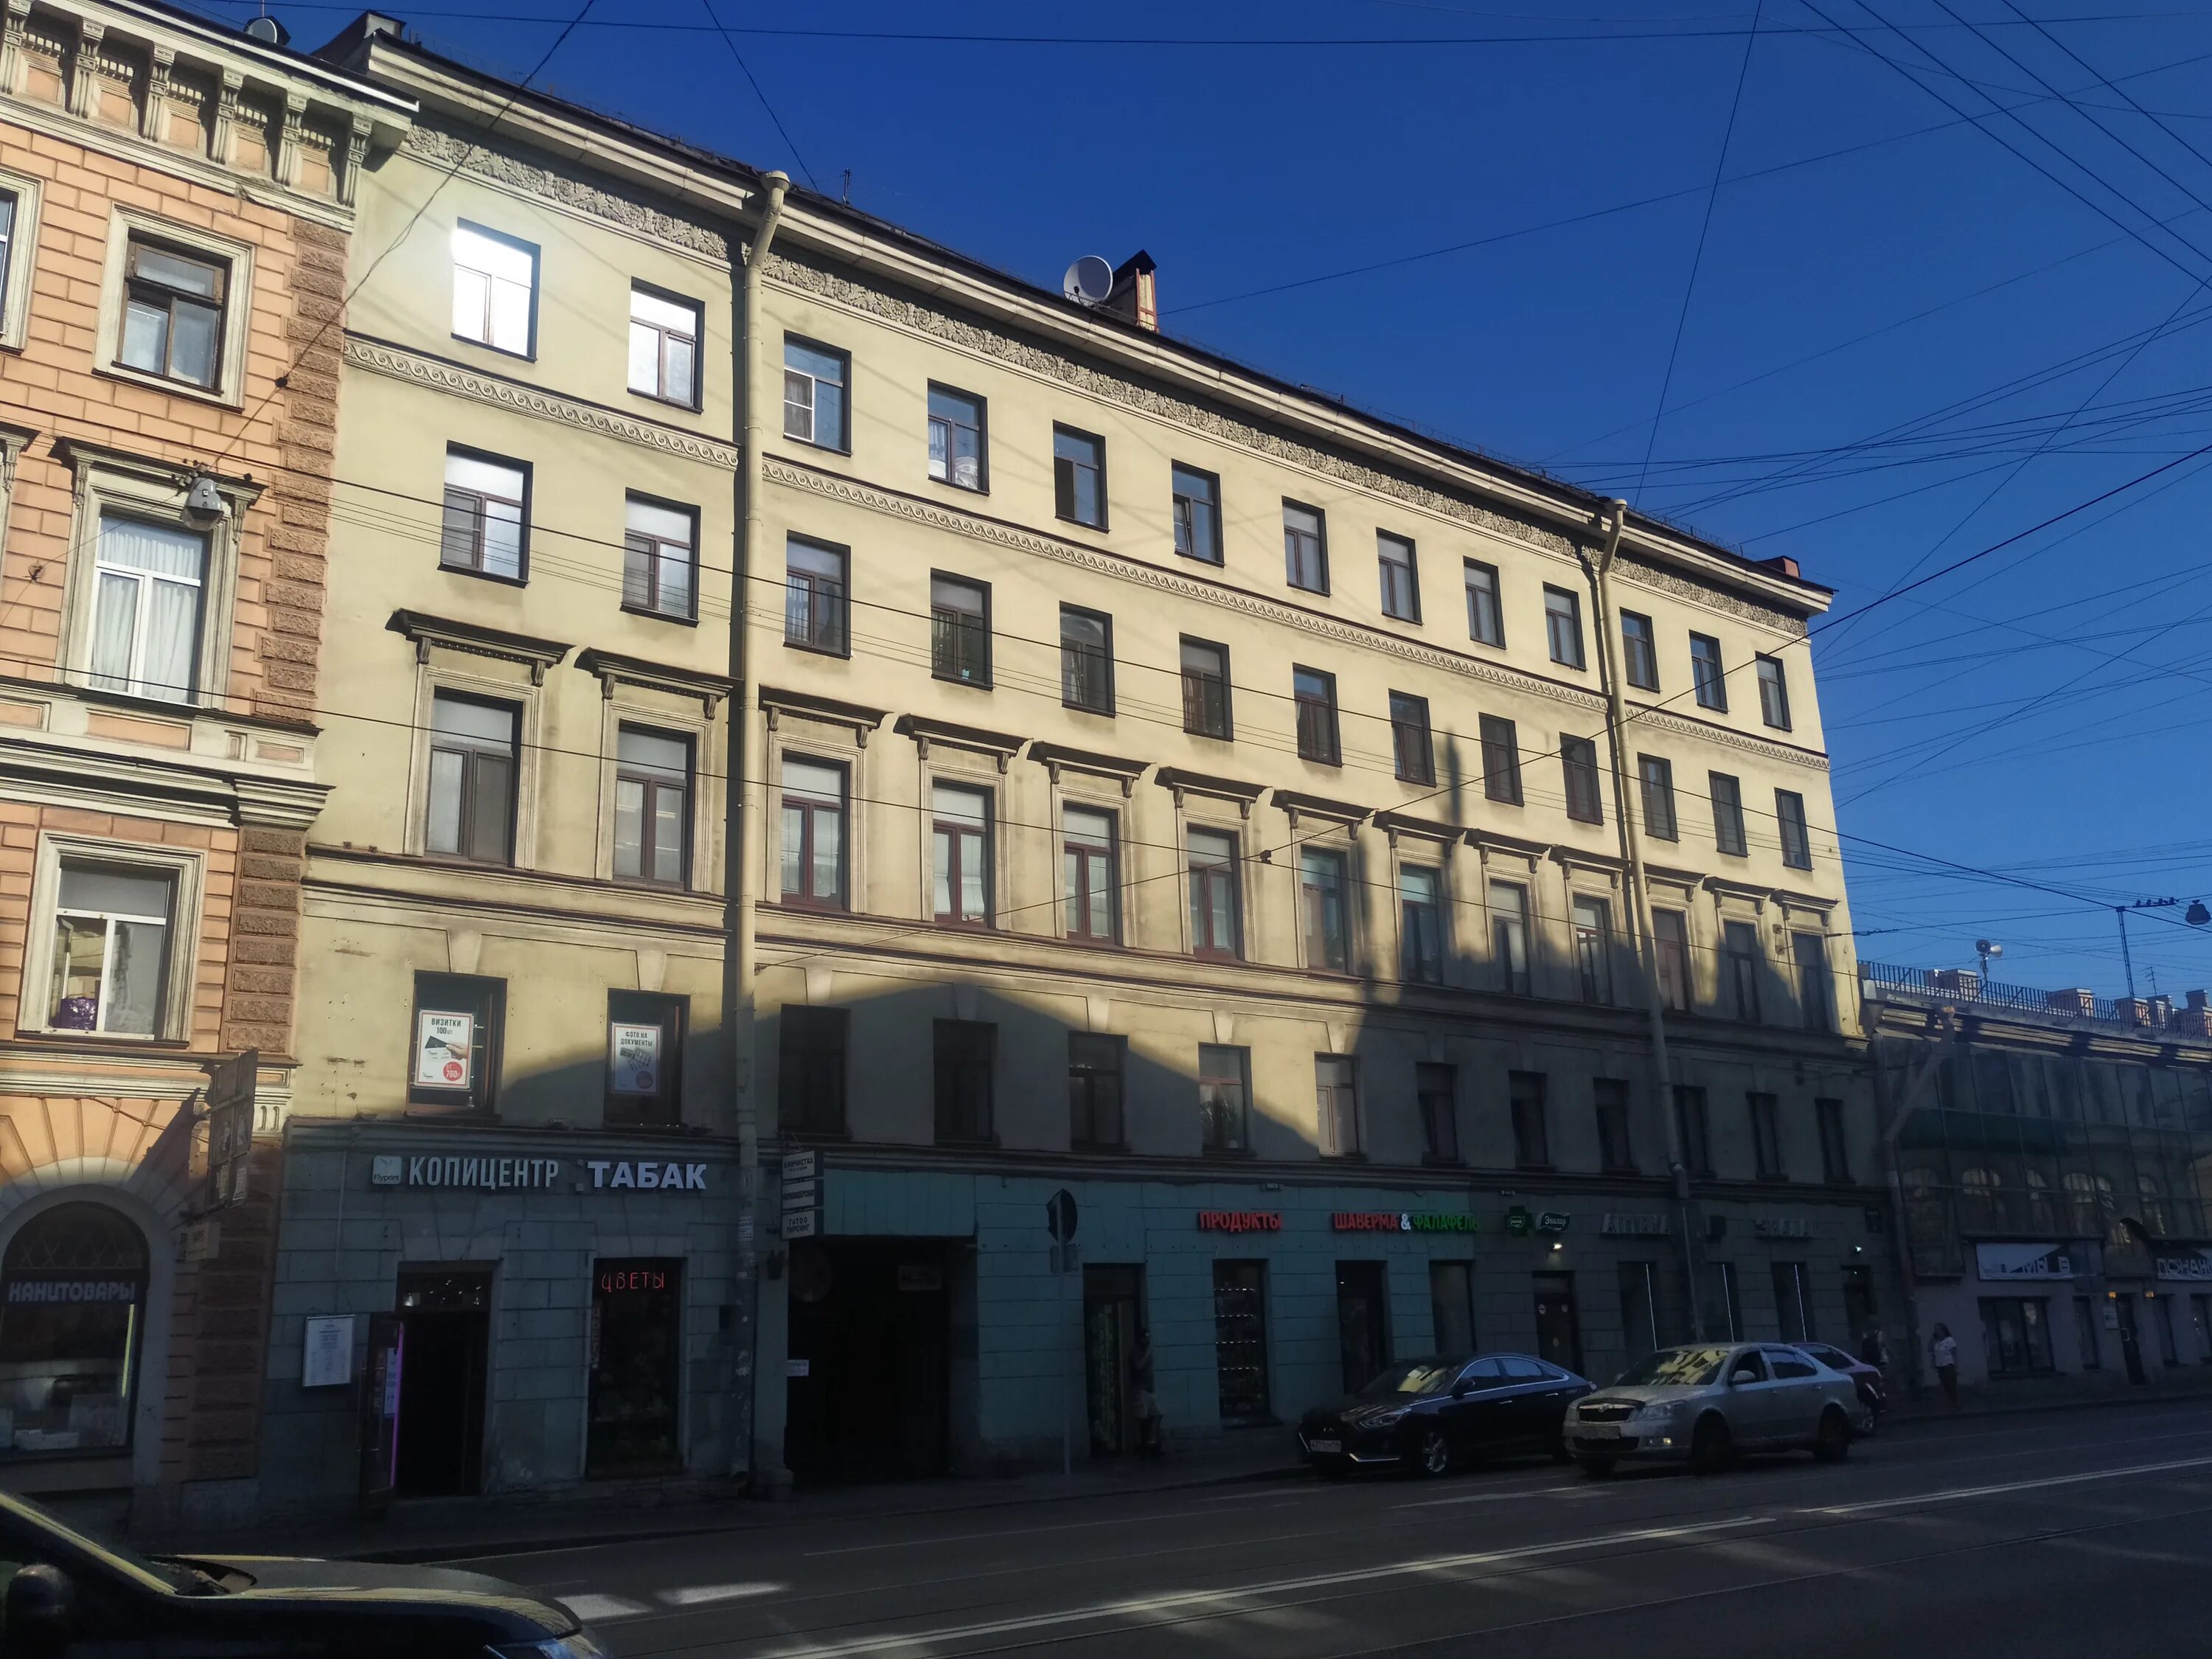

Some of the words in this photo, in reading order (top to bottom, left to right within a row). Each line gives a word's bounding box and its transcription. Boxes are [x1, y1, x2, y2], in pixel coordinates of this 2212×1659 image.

[431, 1018, 462, 1027] ВИЗИТКИ
[620, 1038, 653, 1047] ДОКУМЕНТЫ
[373, 1173, 400, 1183] Flyprint
[408, 1156, 559, 1190] КОПИЦЕНТР
[588, 1161, 707, 1190] ТАБАК
[1199, 1211, 1282, 1233] ПРОДУКТЫ
[1333, 1213, 1399, 1231] ШАВЕРМА
[1400, 1213, 1411, 1231] &
[1413, 1214, 1479, 1231] ФАЛАФЕЛЬ
[601, 1271, 665, 1293] ЦВЕТЫ
